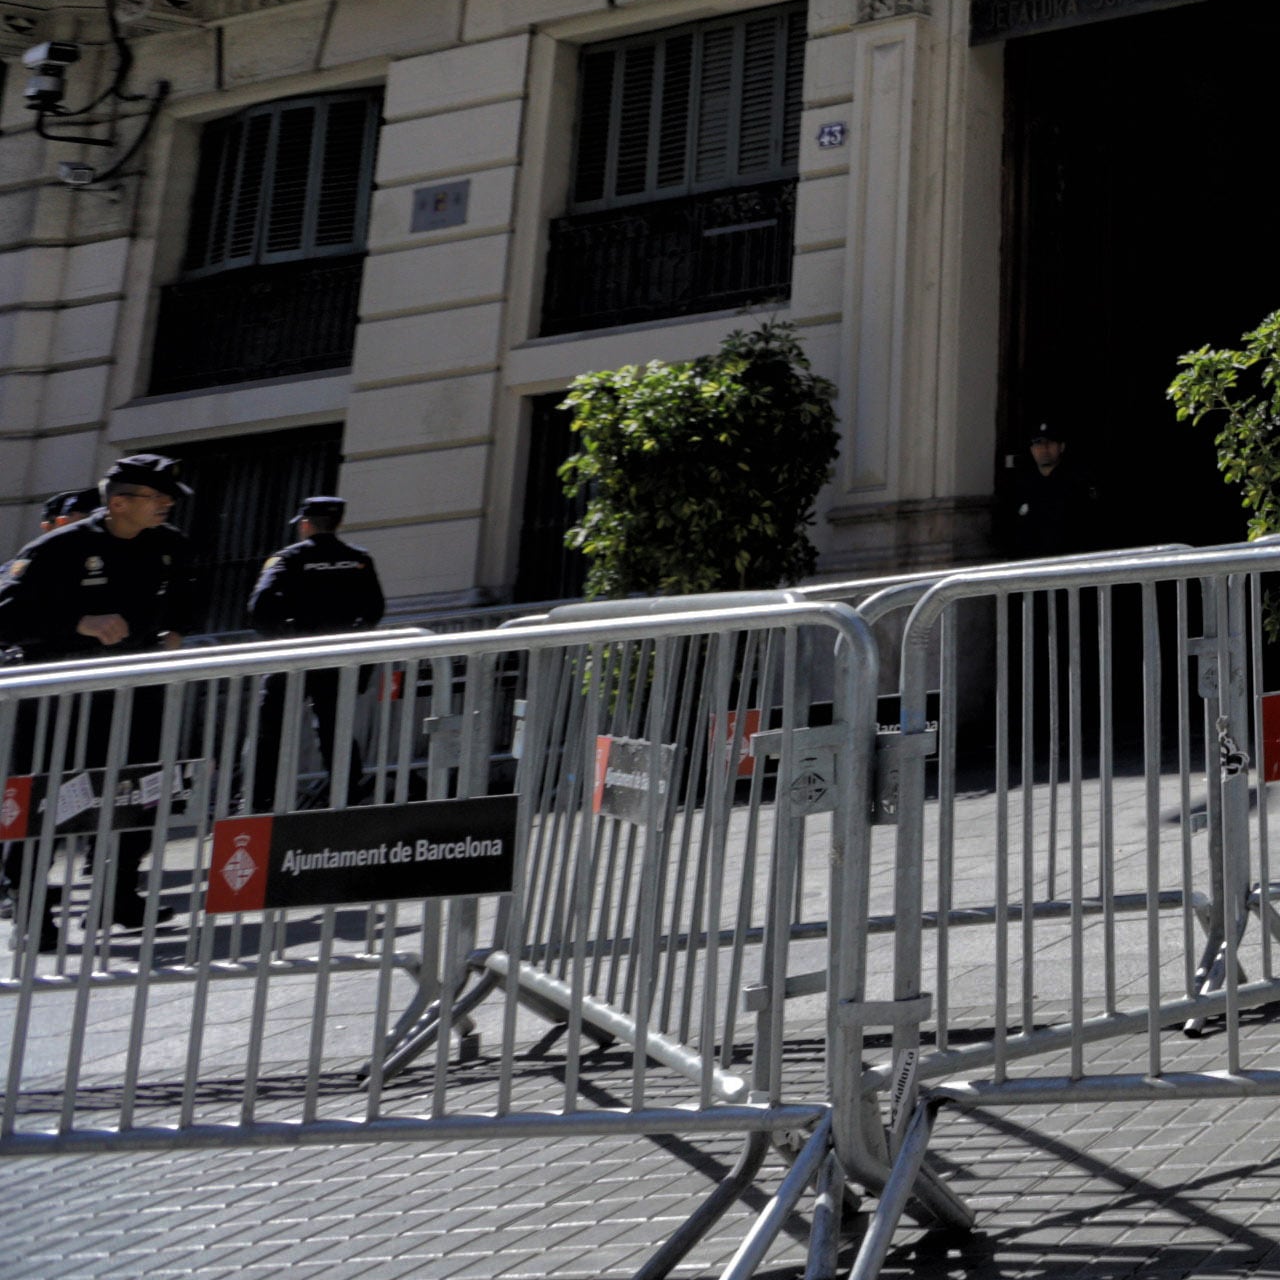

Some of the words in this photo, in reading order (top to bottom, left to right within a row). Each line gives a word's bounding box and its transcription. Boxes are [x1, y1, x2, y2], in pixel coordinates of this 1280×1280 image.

[281, 842, 388, 877] Ajuntament
[389, 840, 413, 863] de
[414, 834, 504, 862] Barcelona
